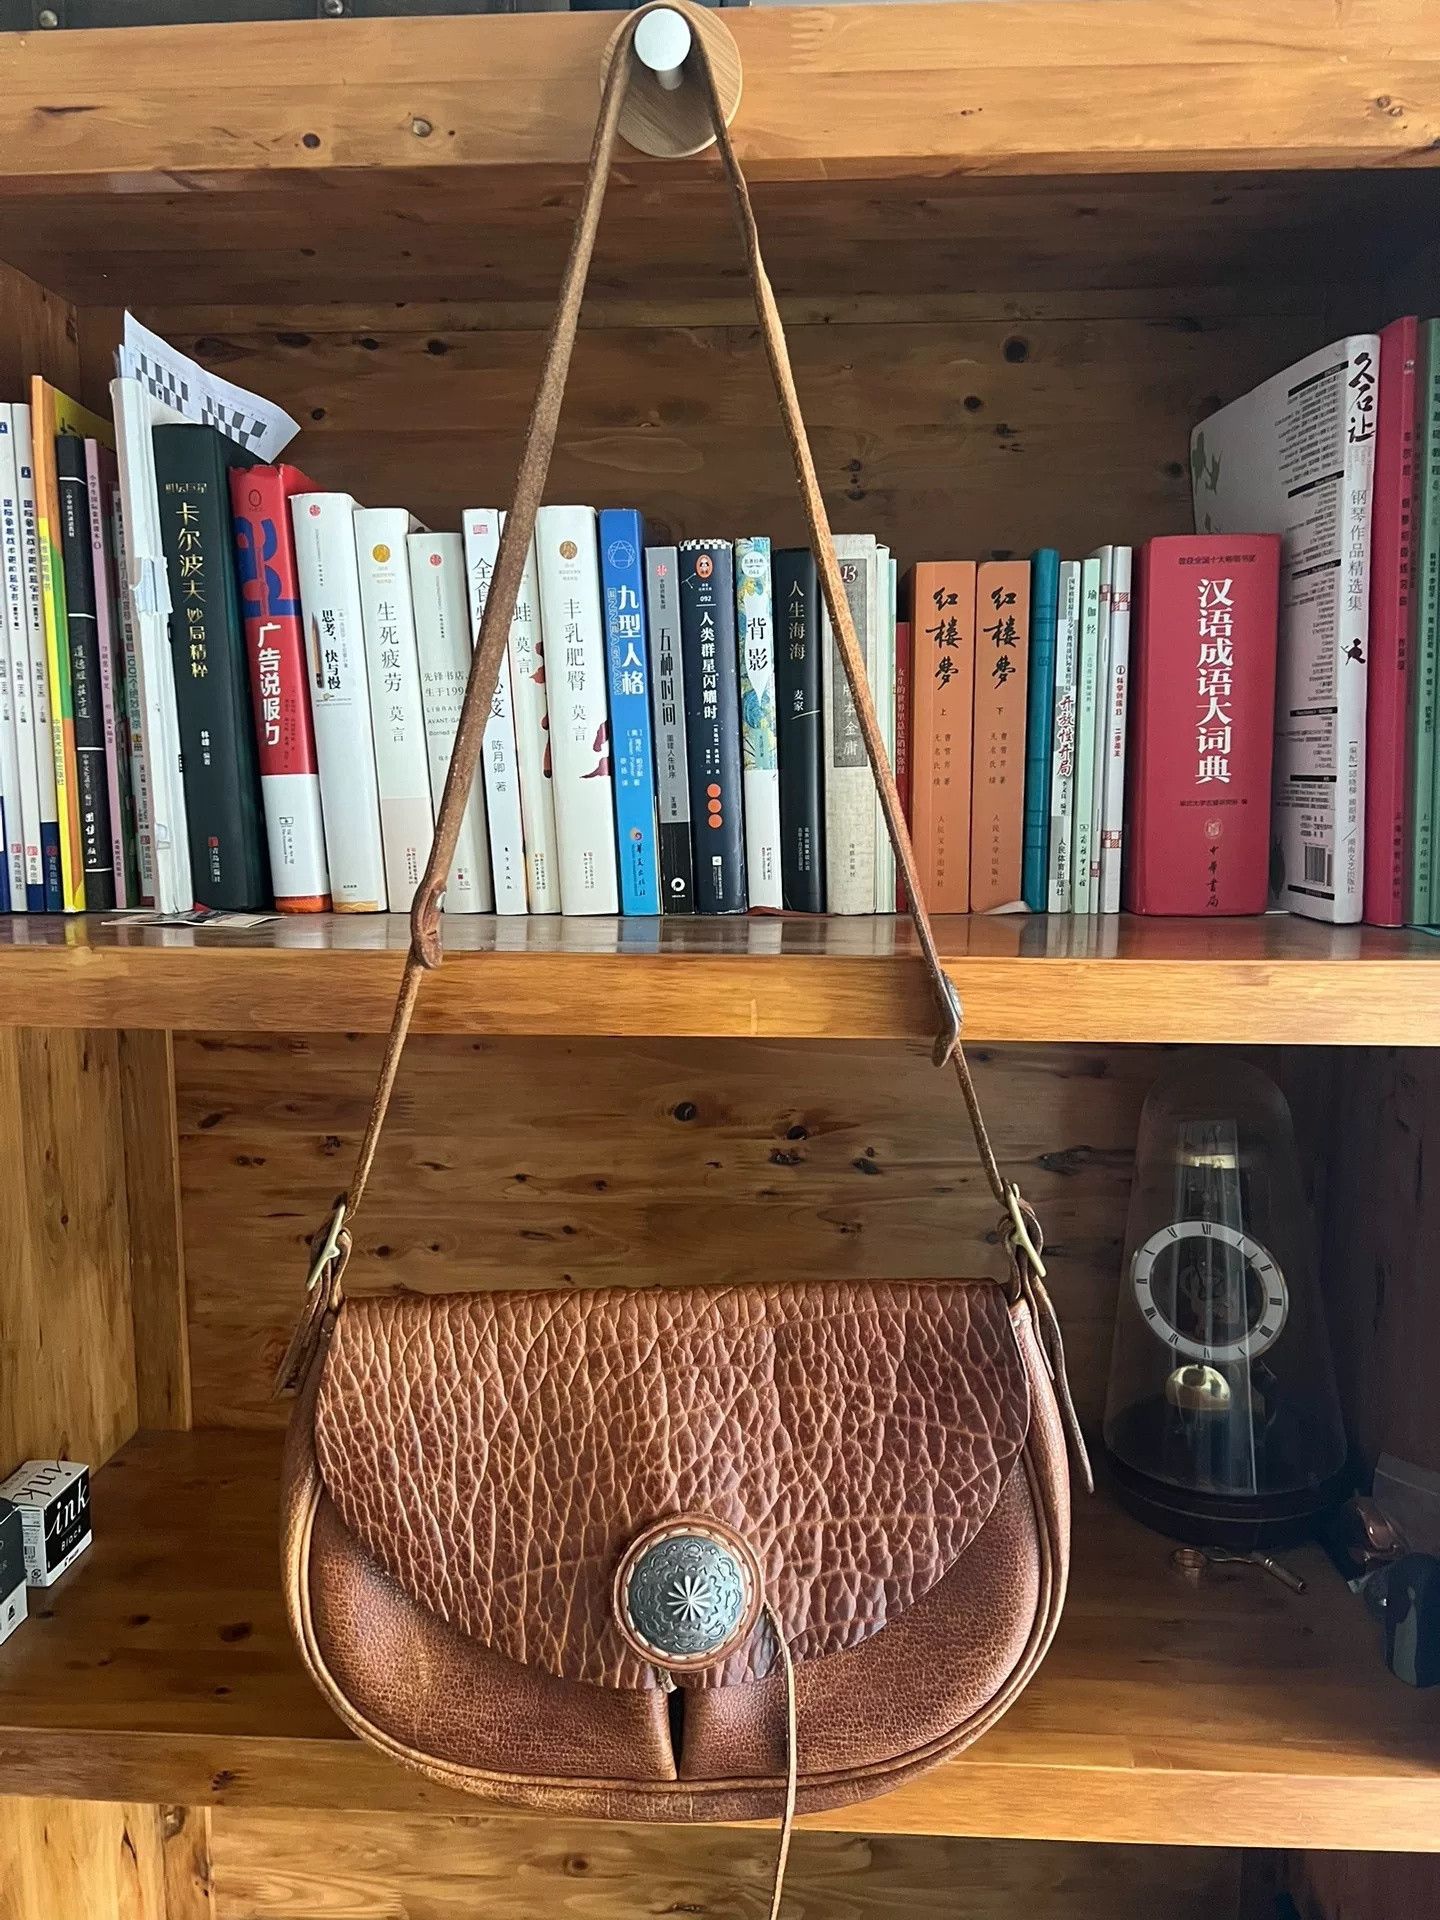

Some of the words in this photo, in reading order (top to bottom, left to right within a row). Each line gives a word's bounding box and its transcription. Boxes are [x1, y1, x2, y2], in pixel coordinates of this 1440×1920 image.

[1347, 488, 1369, 611] 钢琴作品精选集
[513, 601, 532, 623] 蛙
[617, 584, 644, 696] 九型人格
[747, 616, 768, 671] 背影
[788, 579, 805, 660] 人生海海
[377, 600, 402, 693] 生死疲劳
[515, 636, 532, 675] 莫言
[563, 598, 586, 692] 丰乳肥臀
[659, 627, 677, 727] 五种时间
[699, 611, 718, 720] 人类群星闪耀时
[793, 689, 805, 712] 麦家
[1195, 577, 1235, 785] 汉语成语大词典
[388, 704, 405, 743] 莫言
[571, 703, 588, 742] 莫言
[1056, 694, 1076, 778] 开放性开局
[490, 740, 507, 774] 陈月卿
[495, 780, 507, 793] 著
[1056, 837, 1066, 897] 人民体育出版社
[45, 1477, 91, 1541] ink
